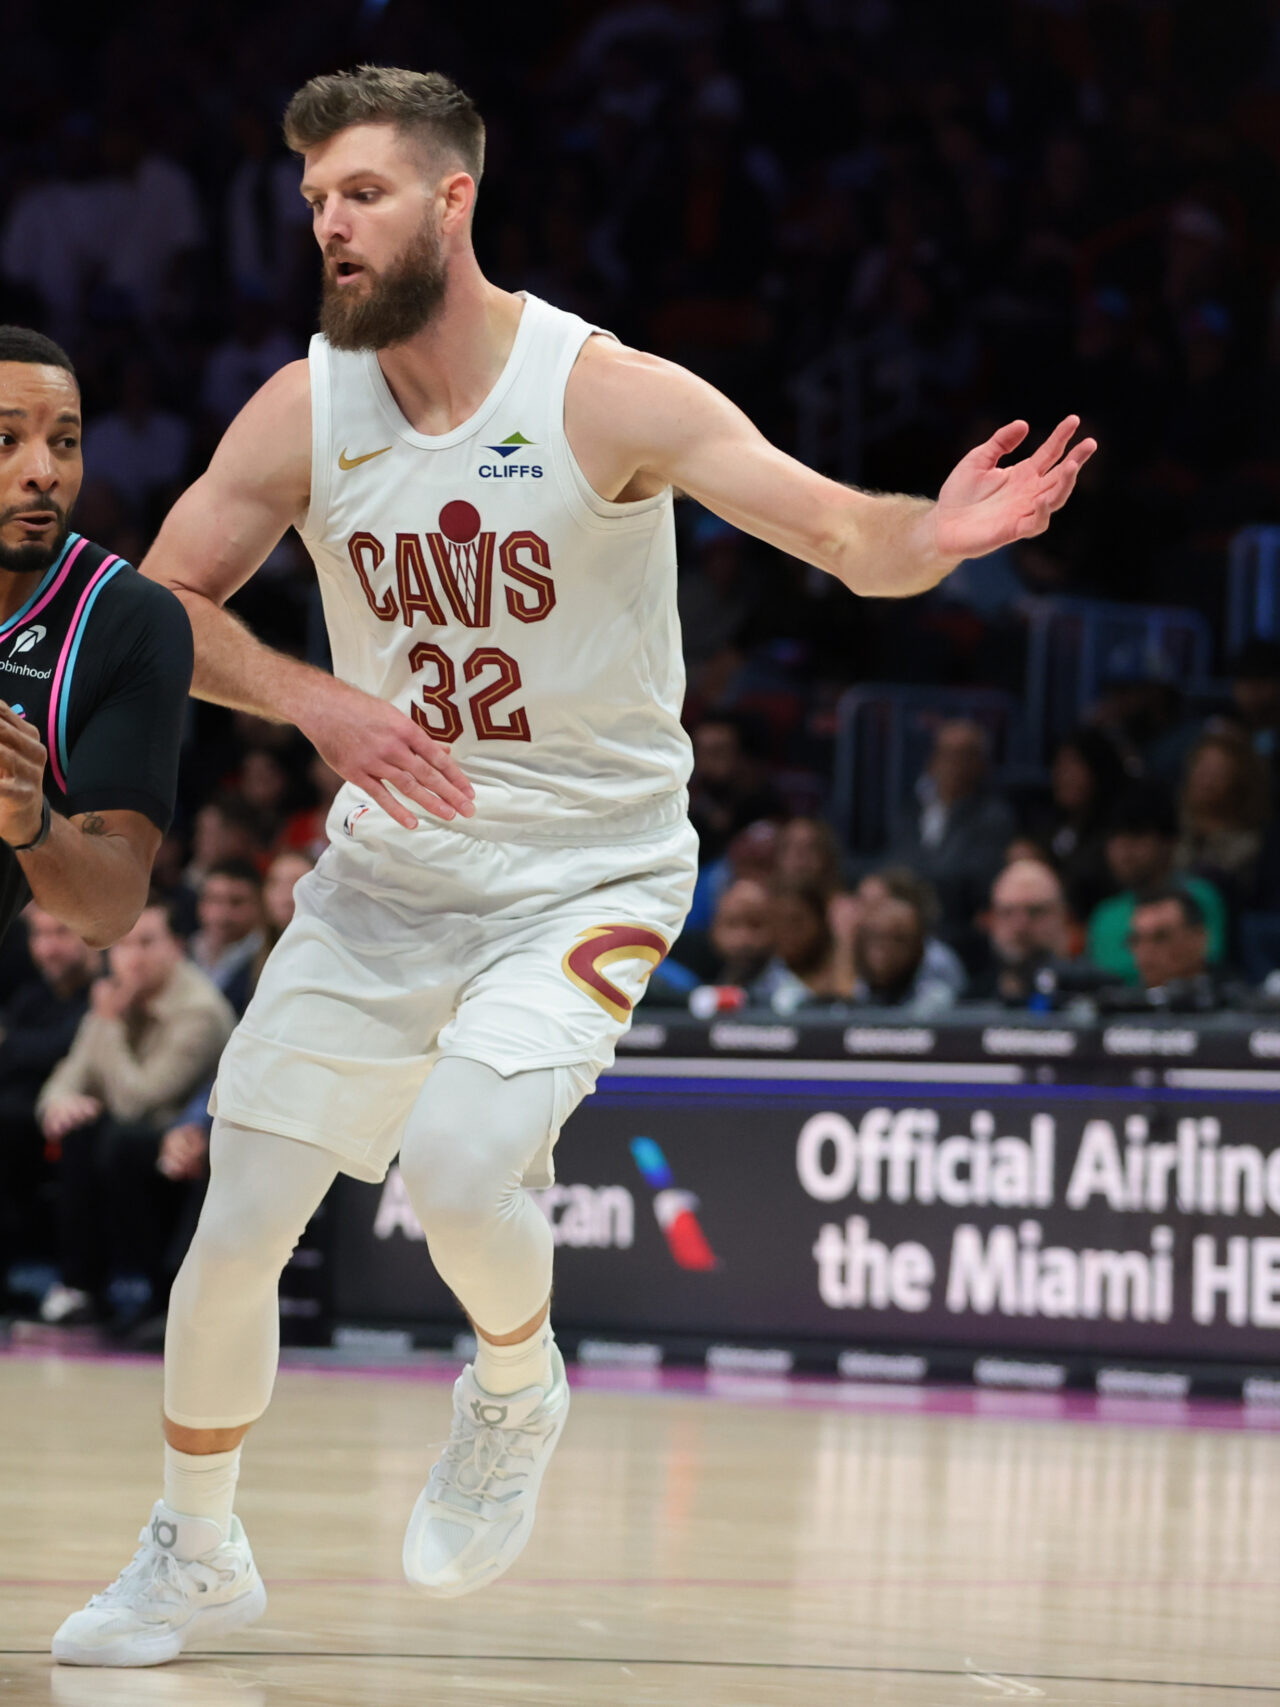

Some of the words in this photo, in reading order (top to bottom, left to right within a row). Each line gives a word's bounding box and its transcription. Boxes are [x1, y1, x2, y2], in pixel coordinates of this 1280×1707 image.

[478, 464, 544, 479] CLIFFS
[347, 530, 557, 628] CAVS
[407, 641, 532, 744] 32
[796, 1107, 1056, 1208] Official
[813, 1215, 936, 1313] the
[946, 1219, 1174, 1323] Miami
